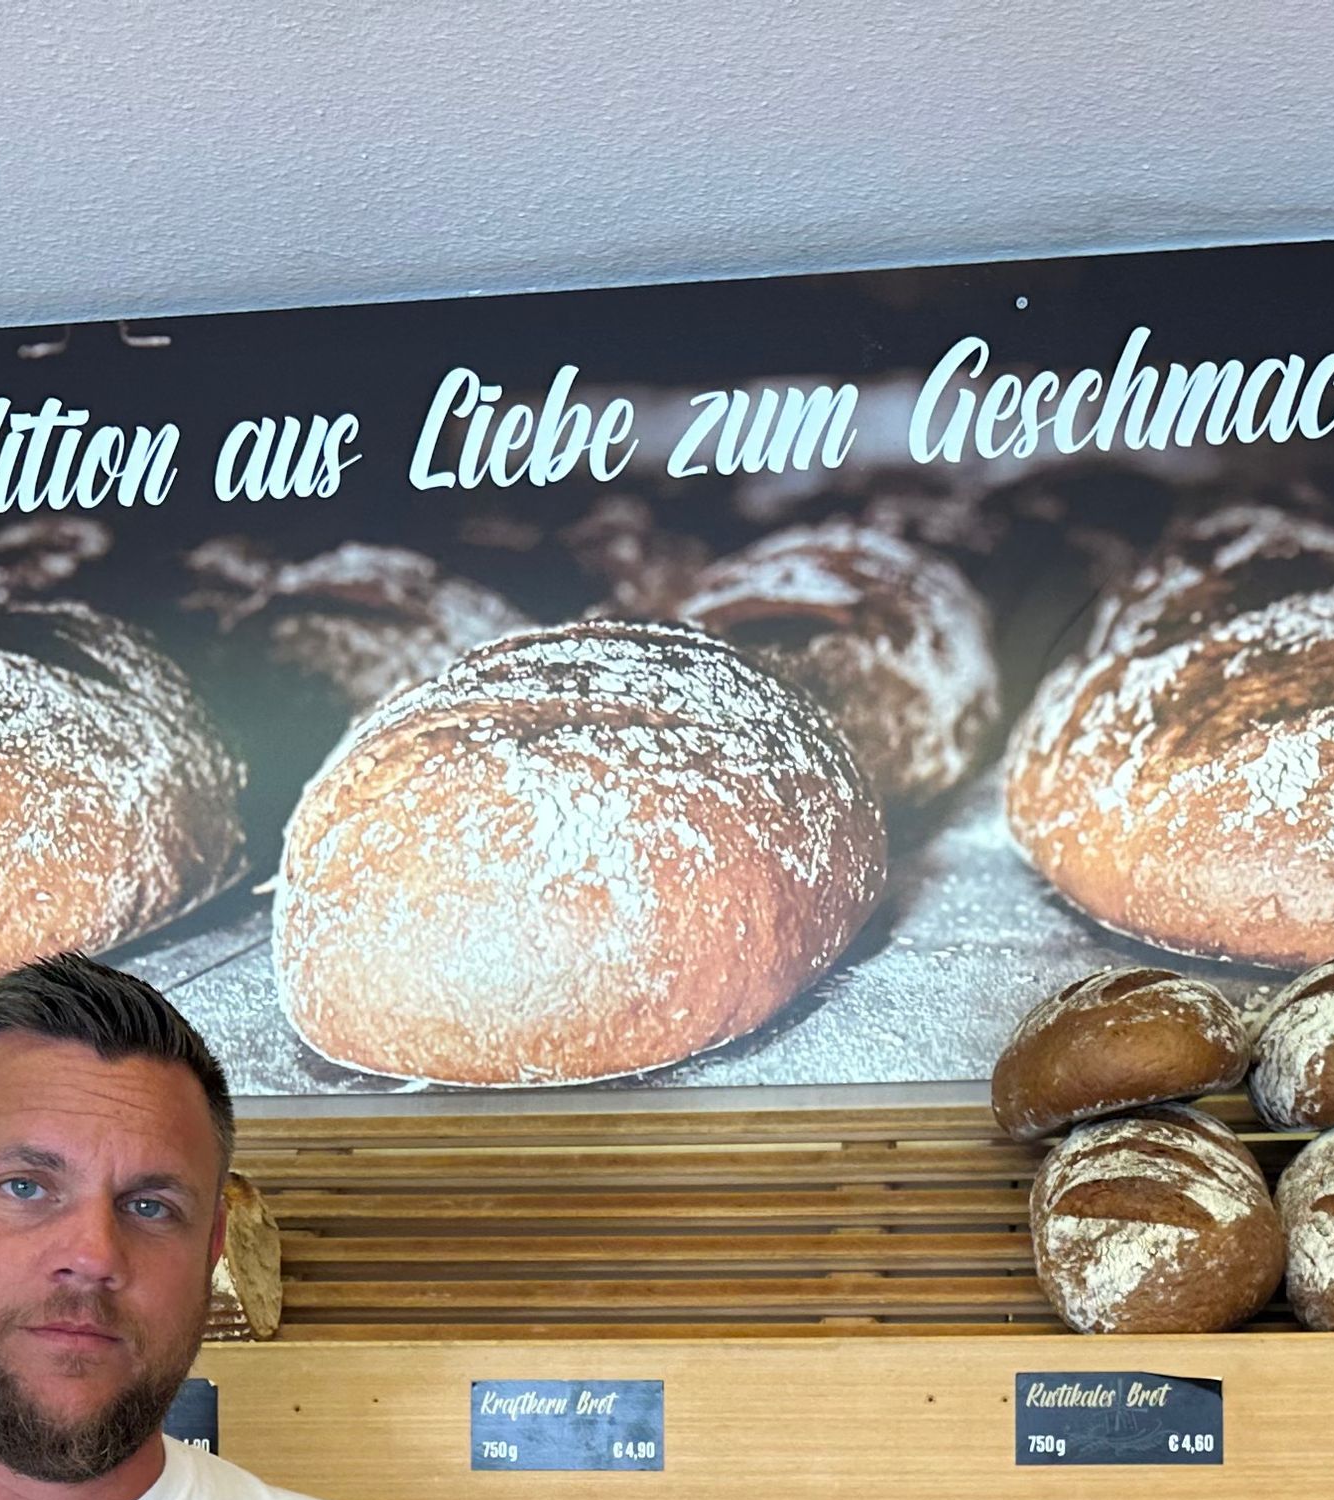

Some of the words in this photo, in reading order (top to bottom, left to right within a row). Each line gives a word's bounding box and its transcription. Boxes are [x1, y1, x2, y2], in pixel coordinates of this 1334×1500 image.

[215, 413, 363, 502] aus
[409, 365, 641, 491] Liebe
[668, 383, 859, 478] zum
[480, 1391, 568, 1421] Kraftkorn
[575, 1391, 619, 1416] Brot
[1025, 1382, 1116, 1408] Rustikales
[1126, 1381, 1173, 1408] Brot
